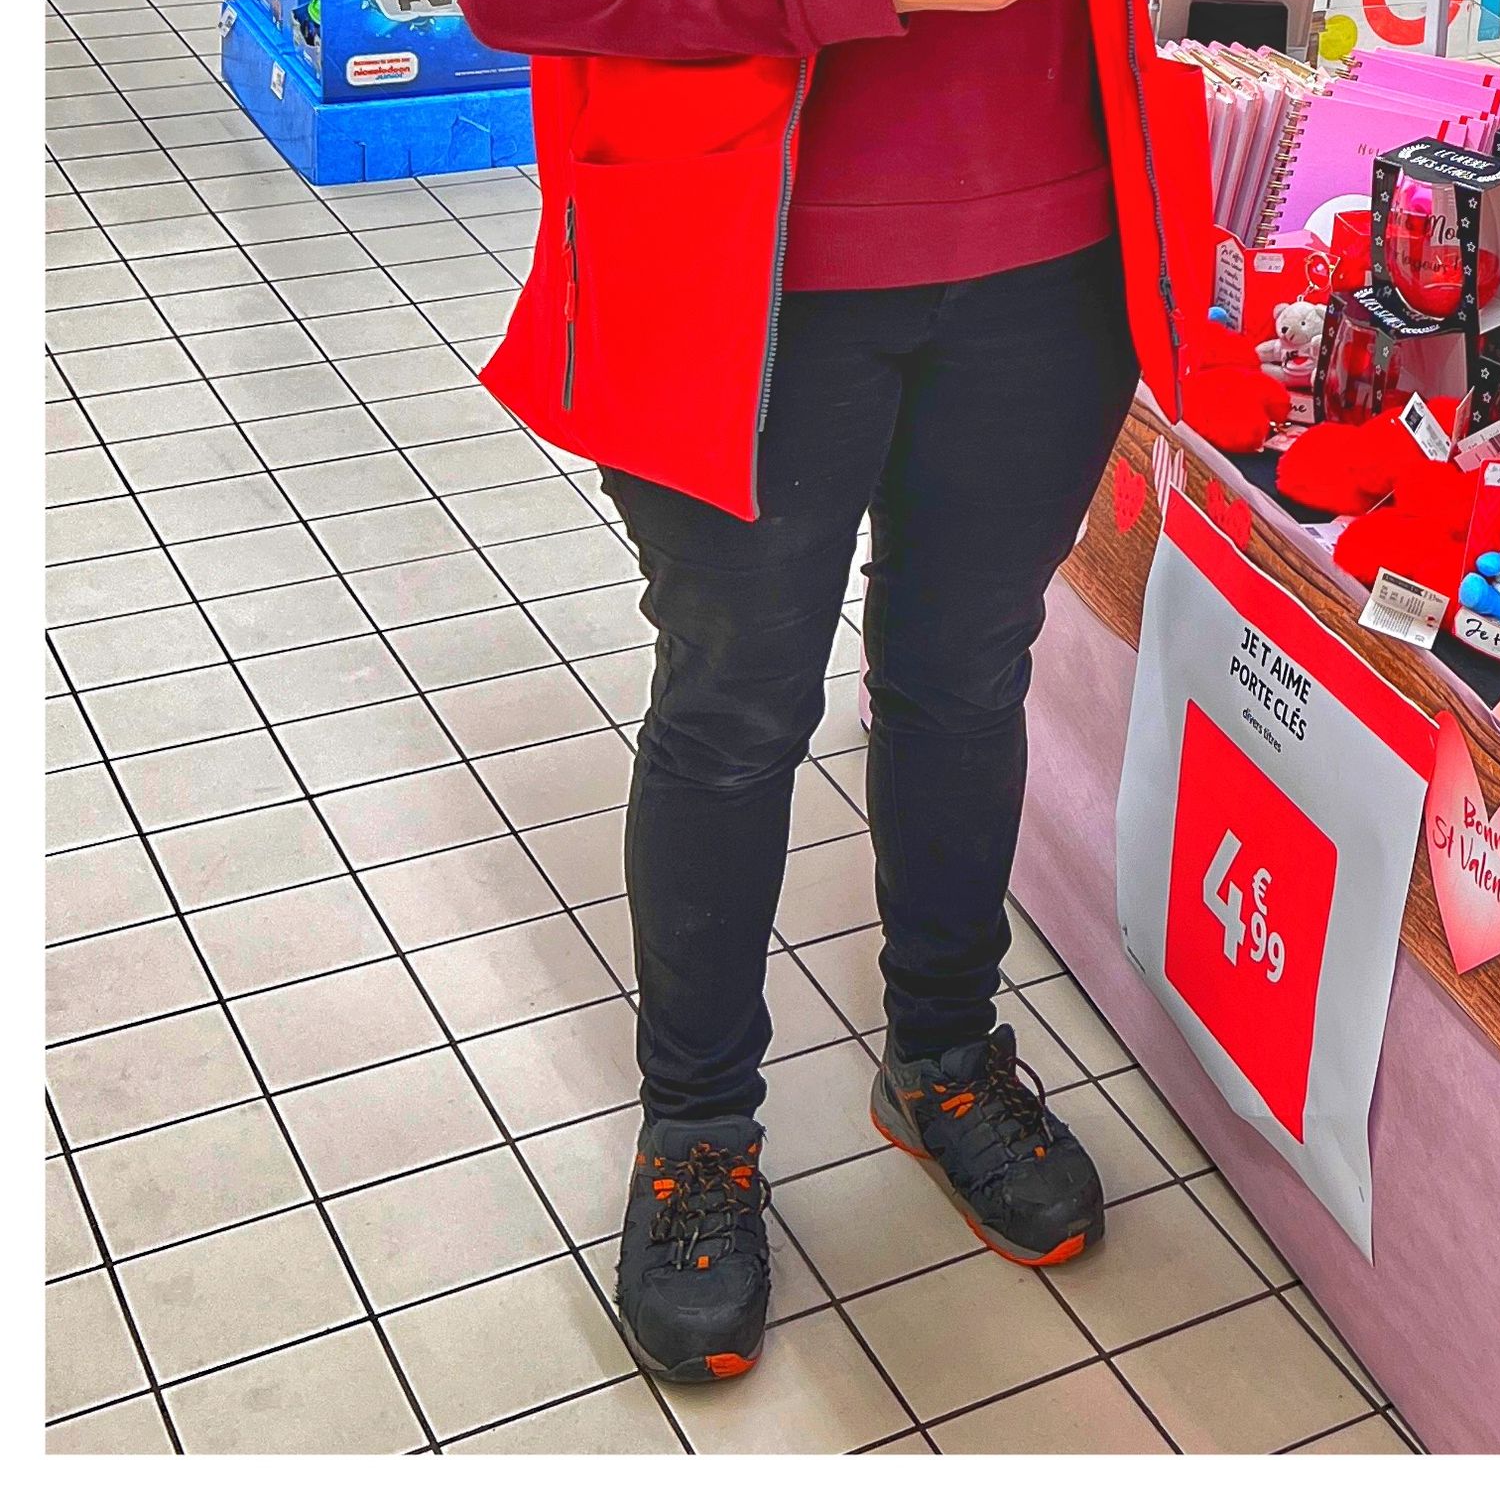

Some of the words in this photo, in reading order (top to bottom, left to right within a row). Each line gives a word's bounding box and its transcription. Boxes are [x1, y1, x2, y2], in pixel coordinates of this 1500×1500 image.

[1465, 617, 1490, 642] Je
[1241, 626, 1262, 660] JE
[1270, 661, 1313, 706] AIME
[1229, 655, 1273, 711] PORTE
[1272, 691, 1309, 742] CLÉS
[1241, 706, 1264, 736] divers
[1262, 727, 1283, 755] titres
[1431, 814, 1456, 860] St
